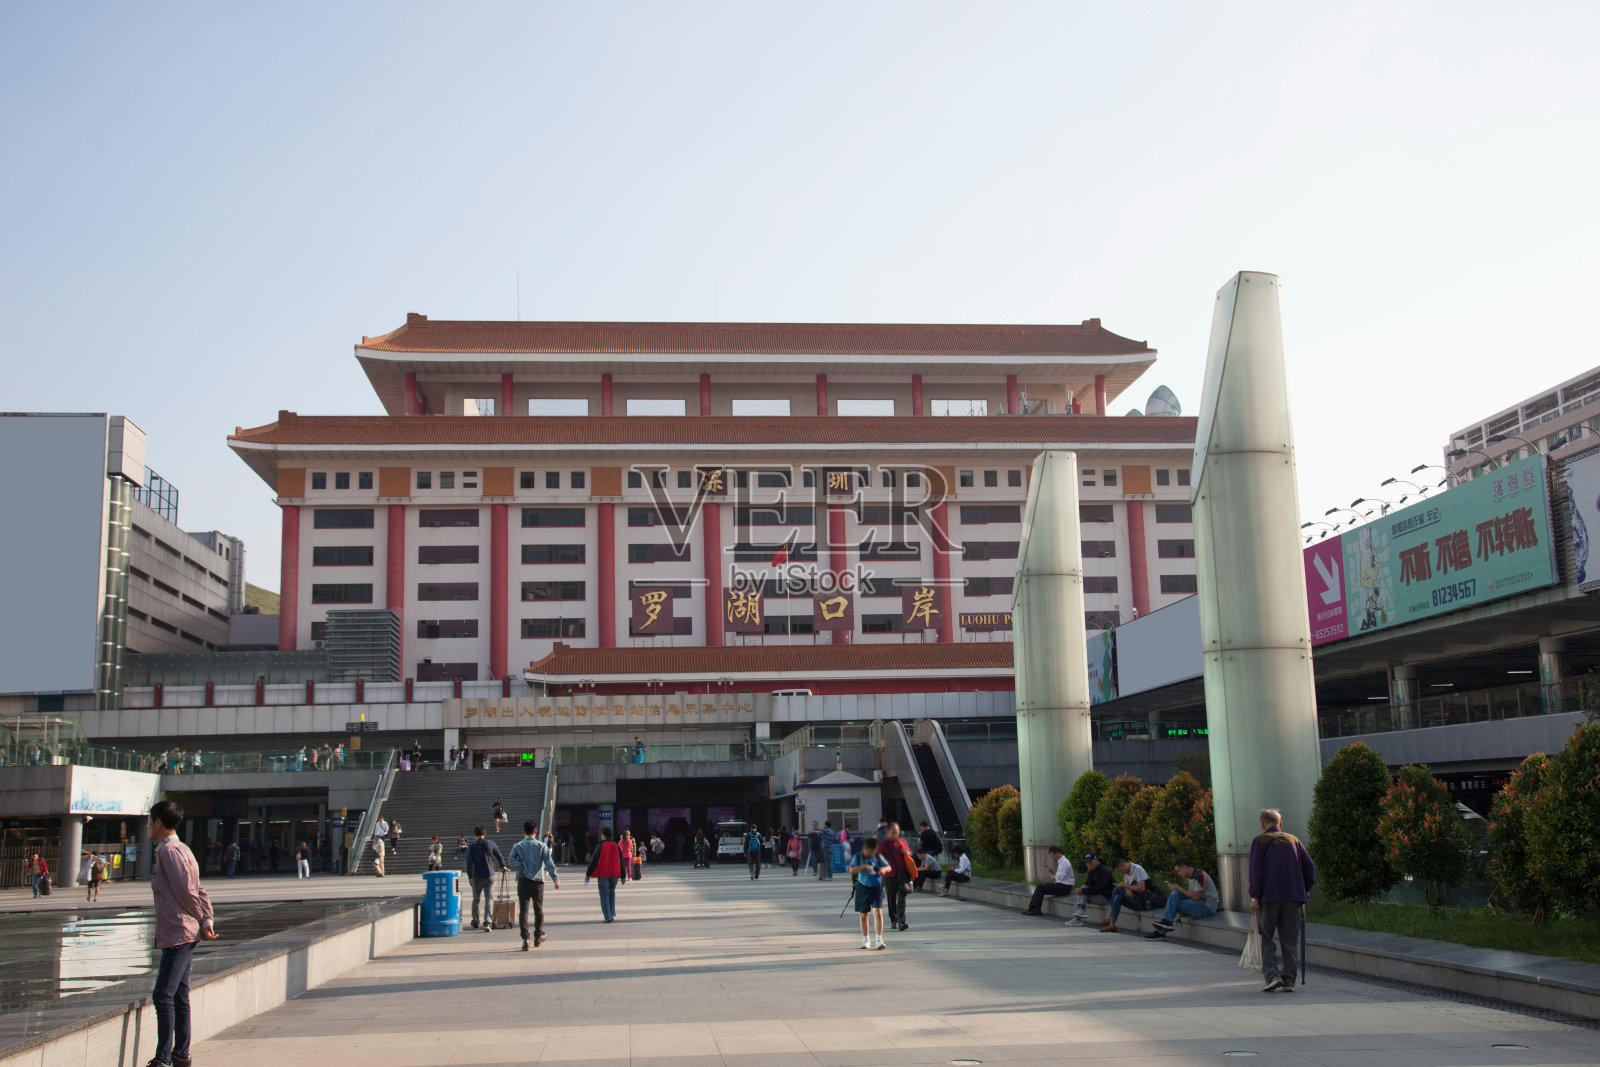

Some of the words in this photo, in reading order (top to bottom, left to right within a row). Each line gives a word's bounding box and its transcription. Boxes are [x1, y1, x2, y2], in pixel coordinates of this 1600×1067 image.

[1398, 541, 1432, 586] 不听
[1435, 529, 1472, 575] 不信
[1475, 506, 1538, 562] 不转账
[639, 586, 941, 631] 罗湖口岸
[1432, 578, 1476, 606] 81234567
[960, 614, 999, 626] LUOHU
